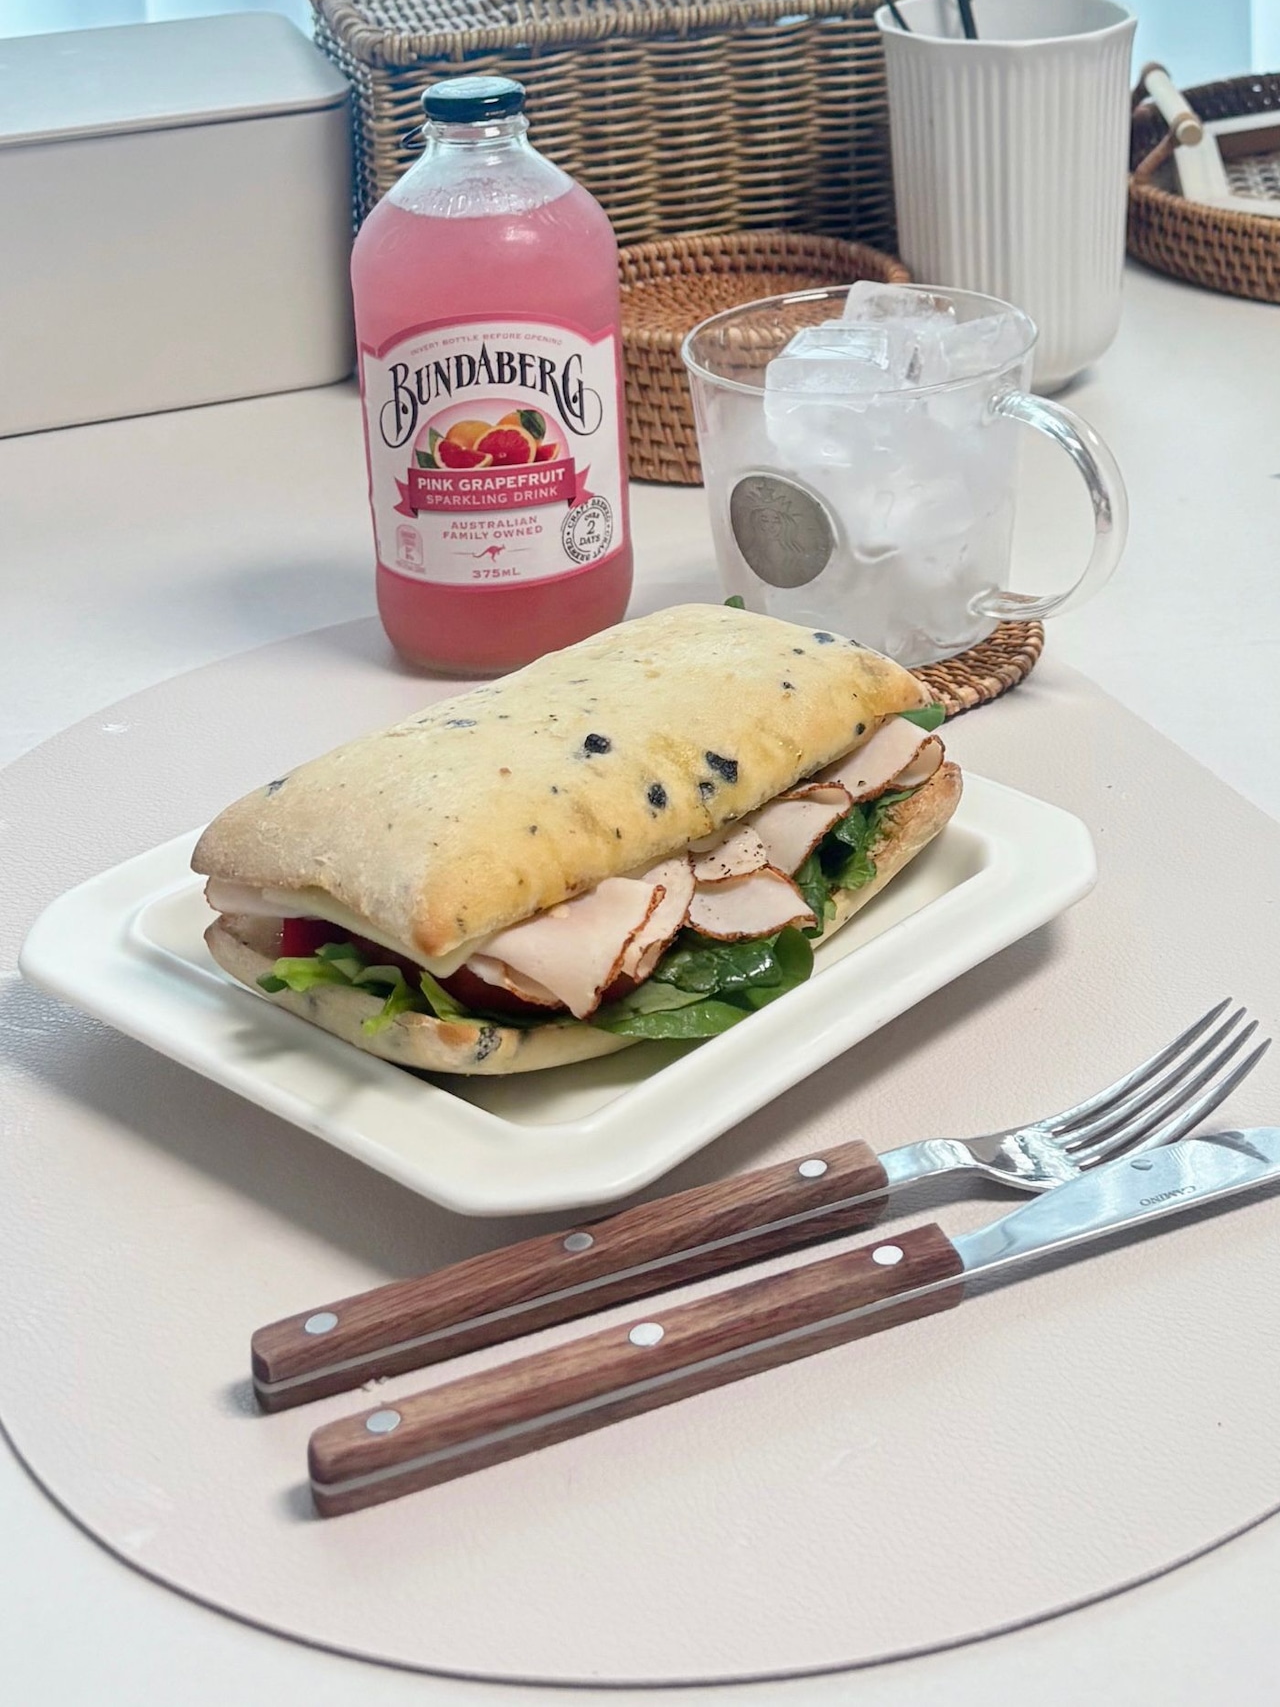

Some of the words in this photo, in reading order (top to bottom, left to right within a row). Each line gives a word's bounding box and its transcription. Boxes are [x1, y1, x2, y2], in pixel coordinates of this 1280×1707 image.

[442, 334, 479, 347] BOTTLE
[483, 332, 521, 341] BEFORE
[524, 333, 563, 347] OPENING
[379, 341, 603, 449] BUNDABERG
[417, 477, 454, 492] PINK
[458, 467, 566, 492] GRAPEFRUIT
[425, 493, 508, 506] SPARKLING
[513, 485, 558, 503] DRINK
[450, 515, 538, 530] AUSTRALIAN
[586, 519, 596, 535] 2
[442, 530, 489, 541] FAMILY
[493, 525, 543, 540] OWNED
[579, 533, 601, 546] DAYS
[1139, 1185, 1197, 1207] CAMINO
